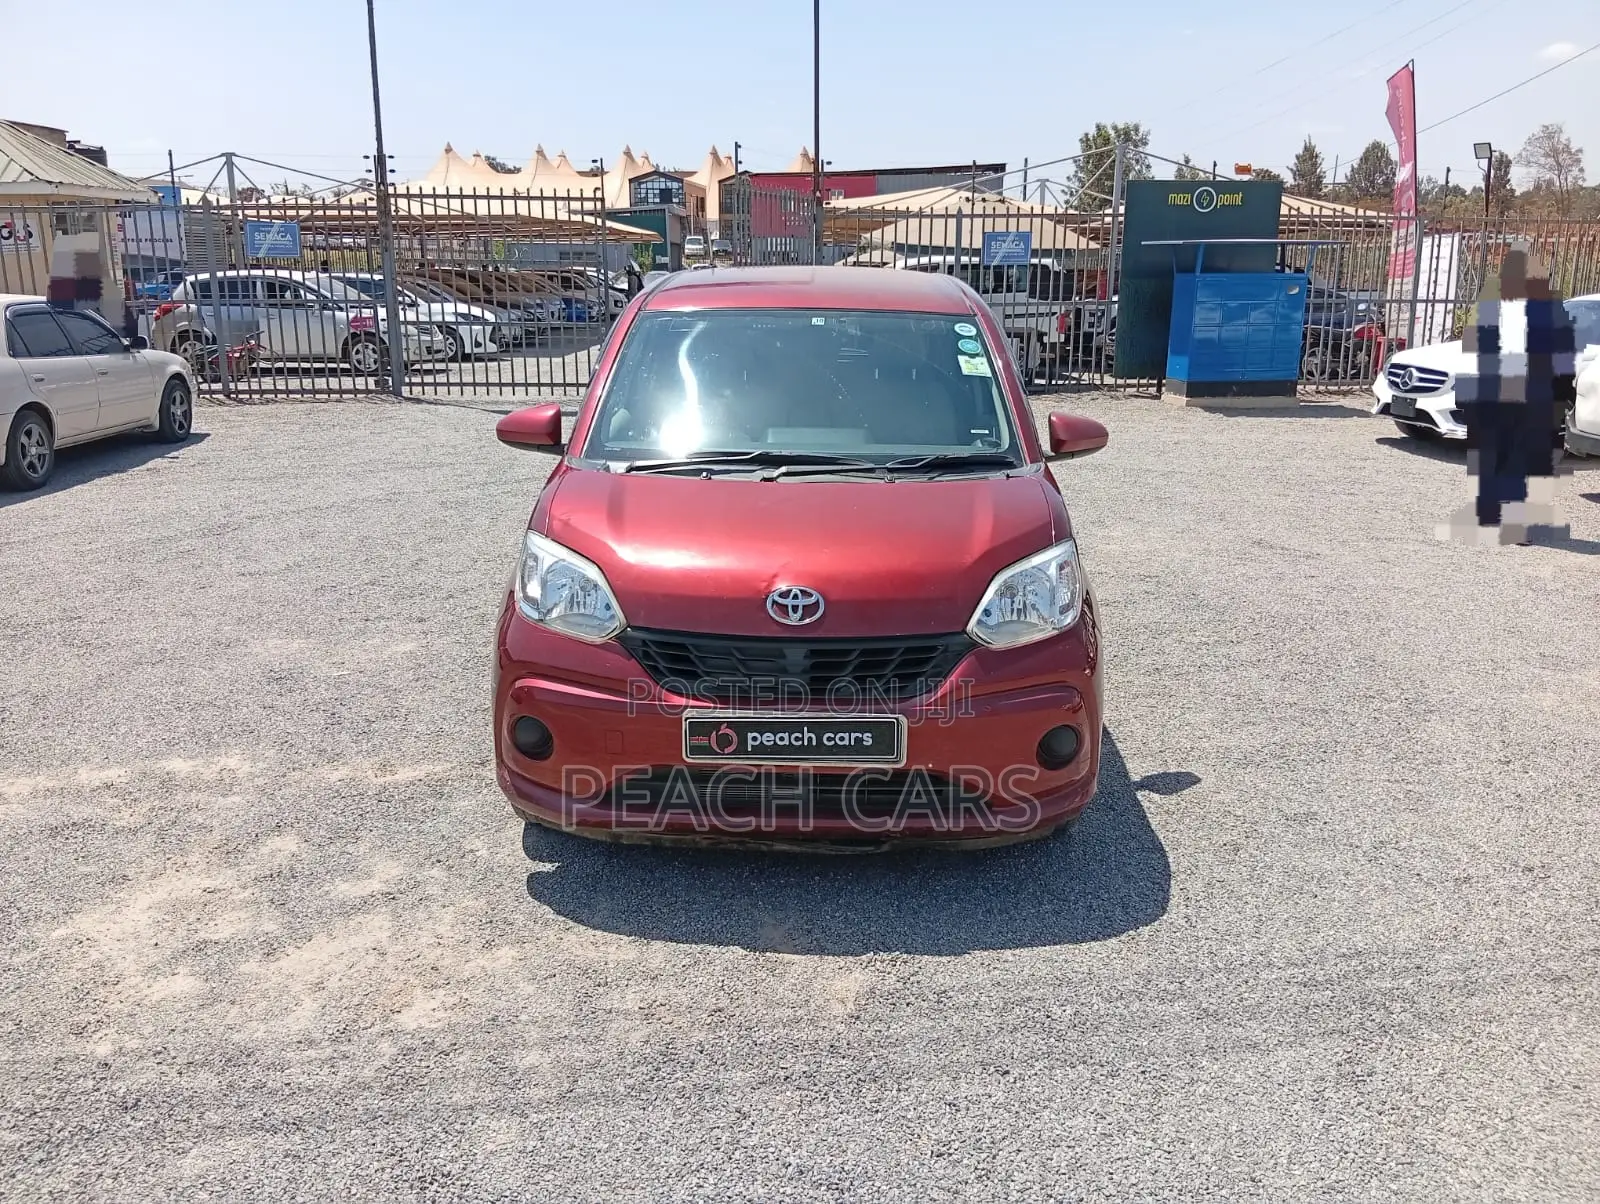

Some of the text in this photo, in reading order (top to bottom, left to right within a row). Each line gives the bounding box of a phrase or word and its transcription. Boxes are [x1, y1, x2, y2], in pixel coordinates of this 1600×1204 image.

[1217, 191, 1243, 209] point
[747, 726, 873, 752] peach cars
